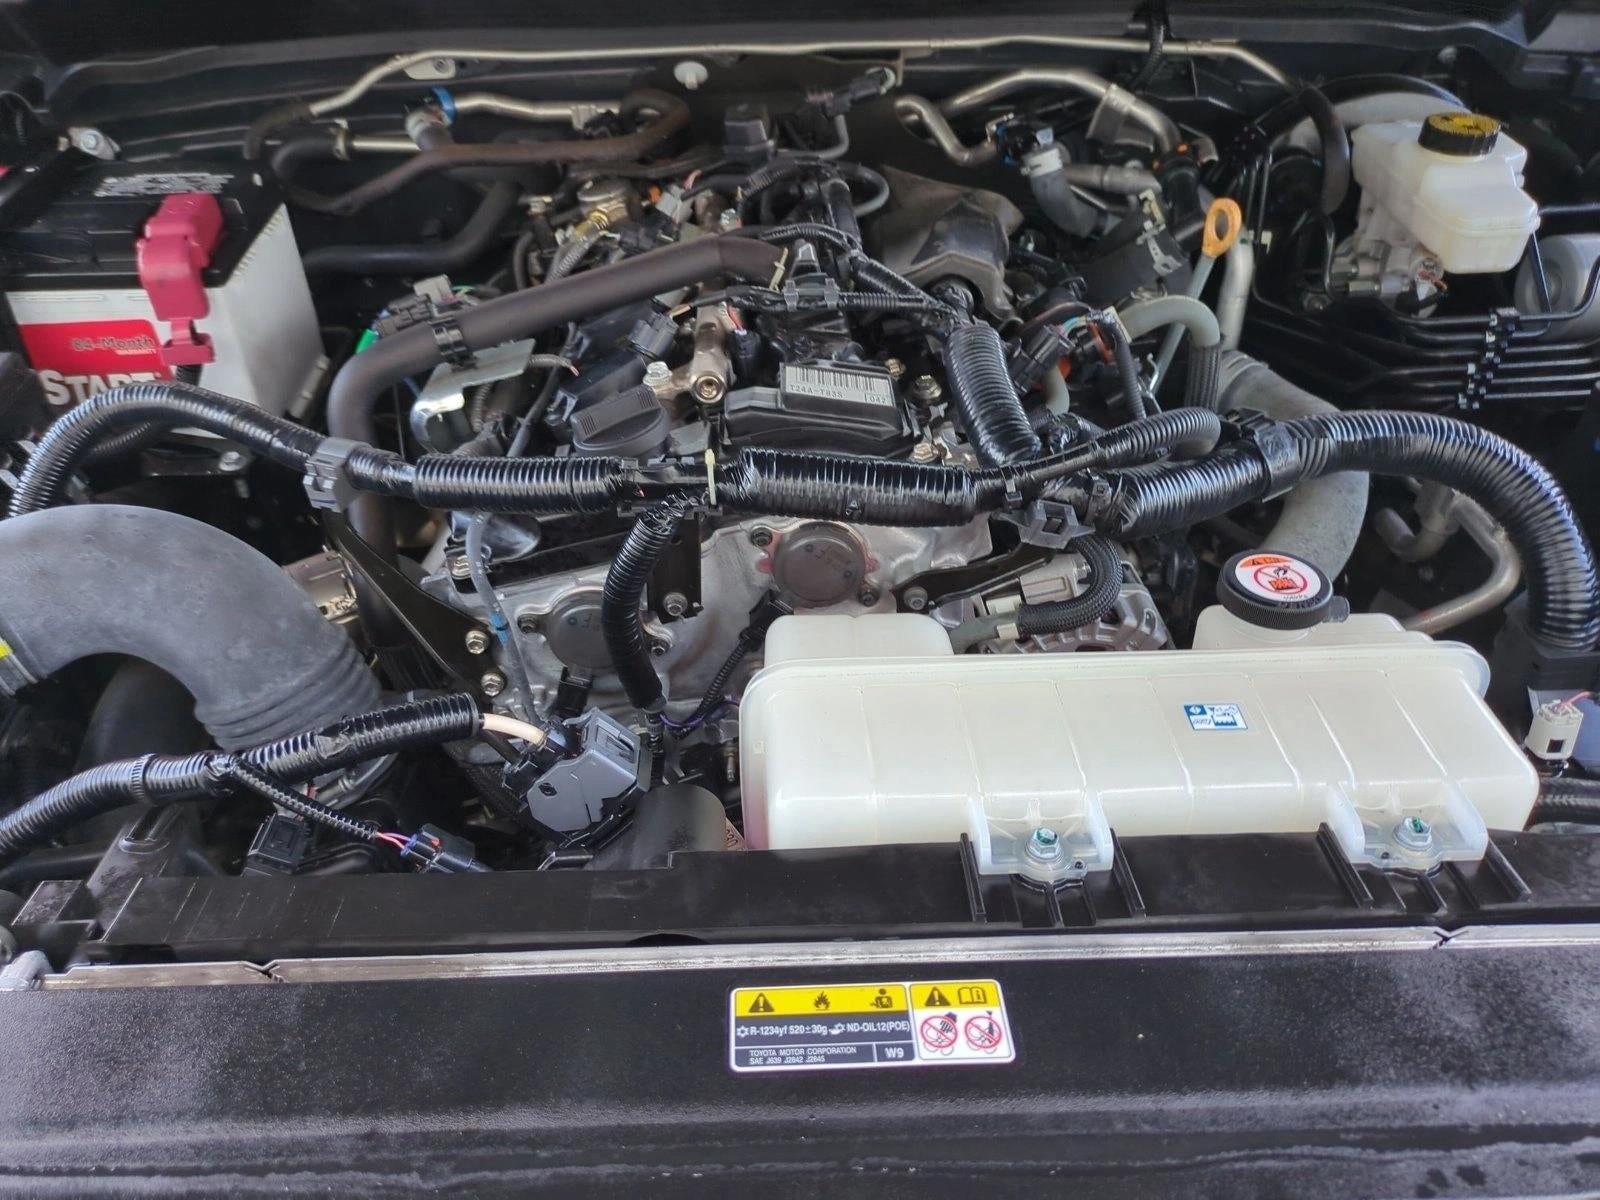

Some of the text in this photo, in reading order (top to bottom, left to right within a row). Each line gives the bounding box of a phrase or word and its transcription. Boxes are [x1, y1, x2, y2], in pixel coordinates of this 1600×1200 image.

[749, 1025, 788, 1037] R-1234yf
[789, 1024, 828, 1036] 520±30g
[749, 1046, 857, 1057] TOYOTA MOTOR CORPORATION
[885, 1047, 904, 1058] W9
